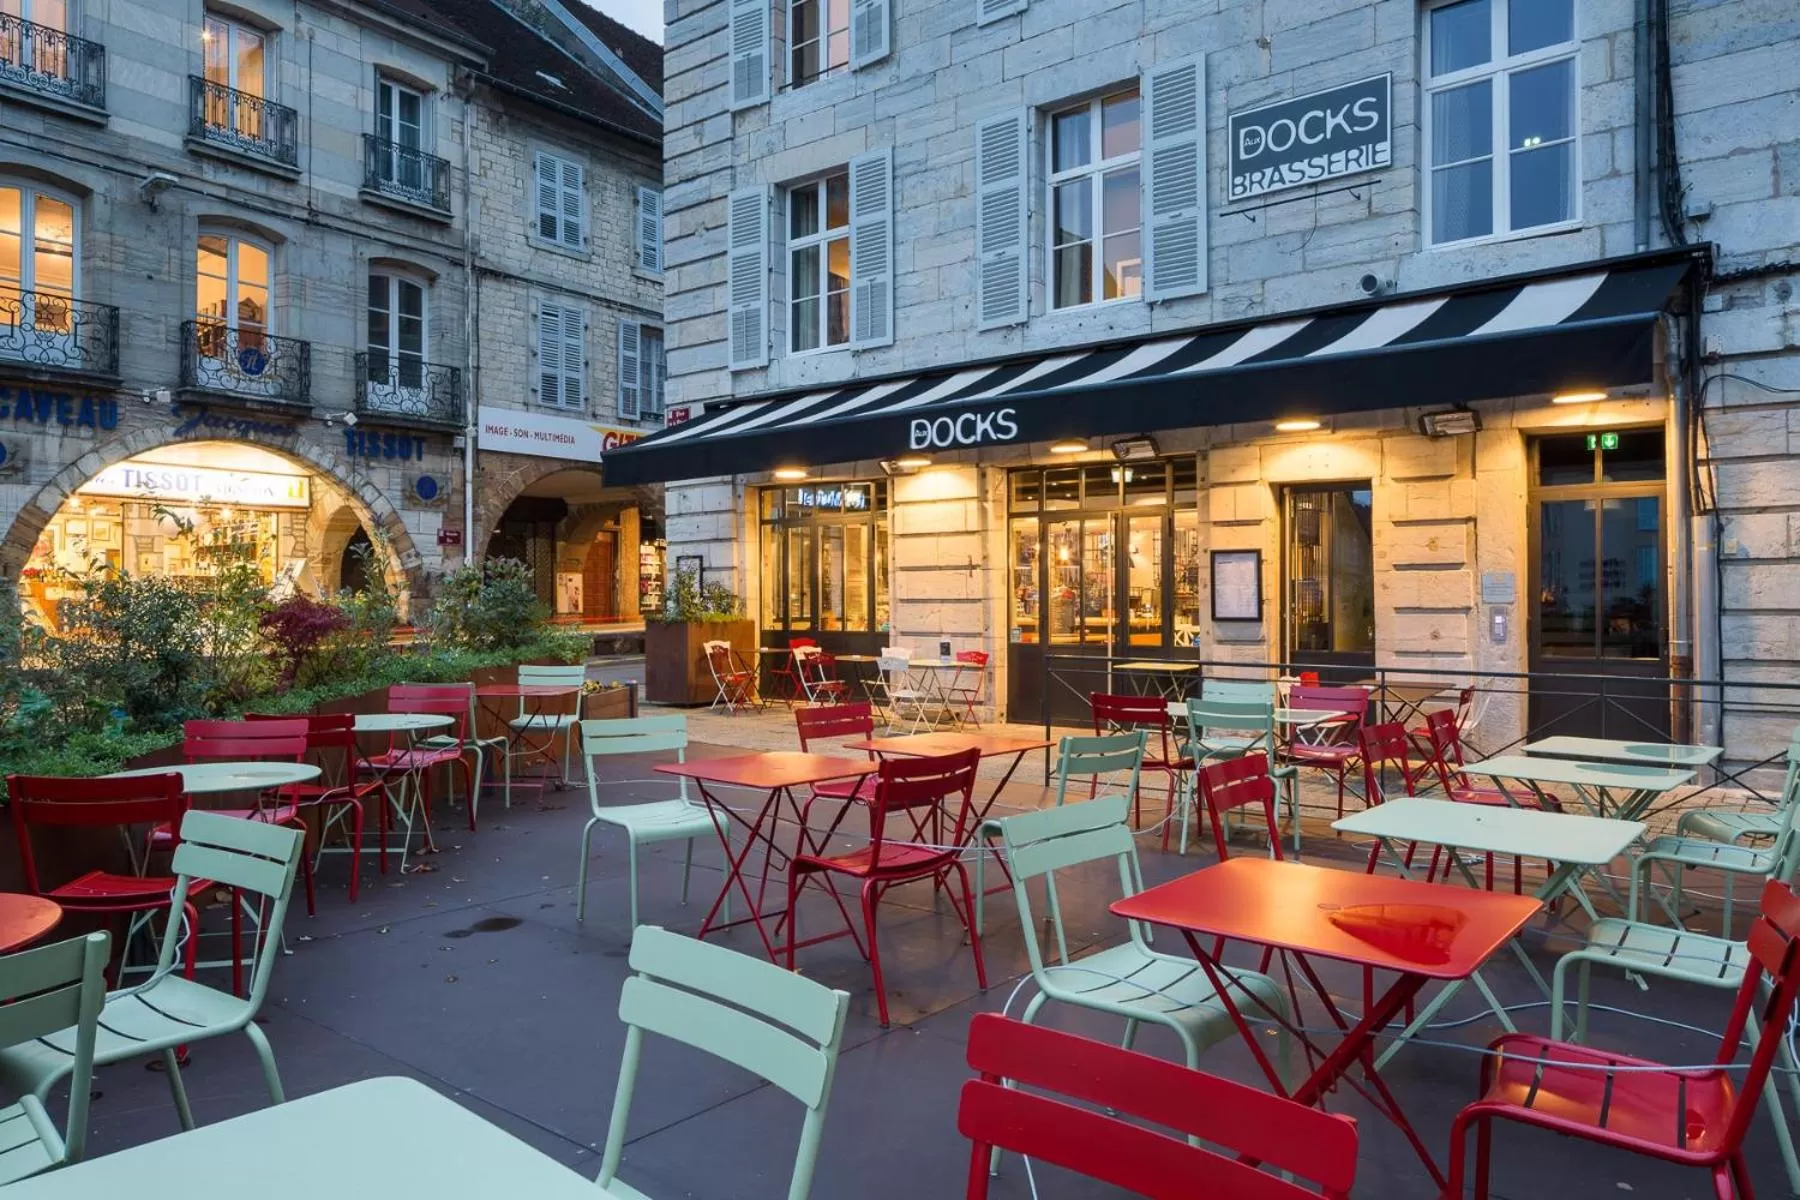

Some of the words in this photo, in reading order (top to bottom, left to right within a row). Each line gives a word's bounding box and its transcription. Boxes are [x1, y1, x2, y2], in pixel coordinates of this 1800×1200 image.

[1239, 97, 1379, 160] DOCKS
[1233, 142, 1389, 195] BRASSERIE
[343, 427, 425, 461] TISSOT
[485, 424, 509, 436] IMAGE
[513, 428, 529, 439] SON
[910, 408, 1018, 449] DOCKS
[122, 469, 205, 492] TISSOT
